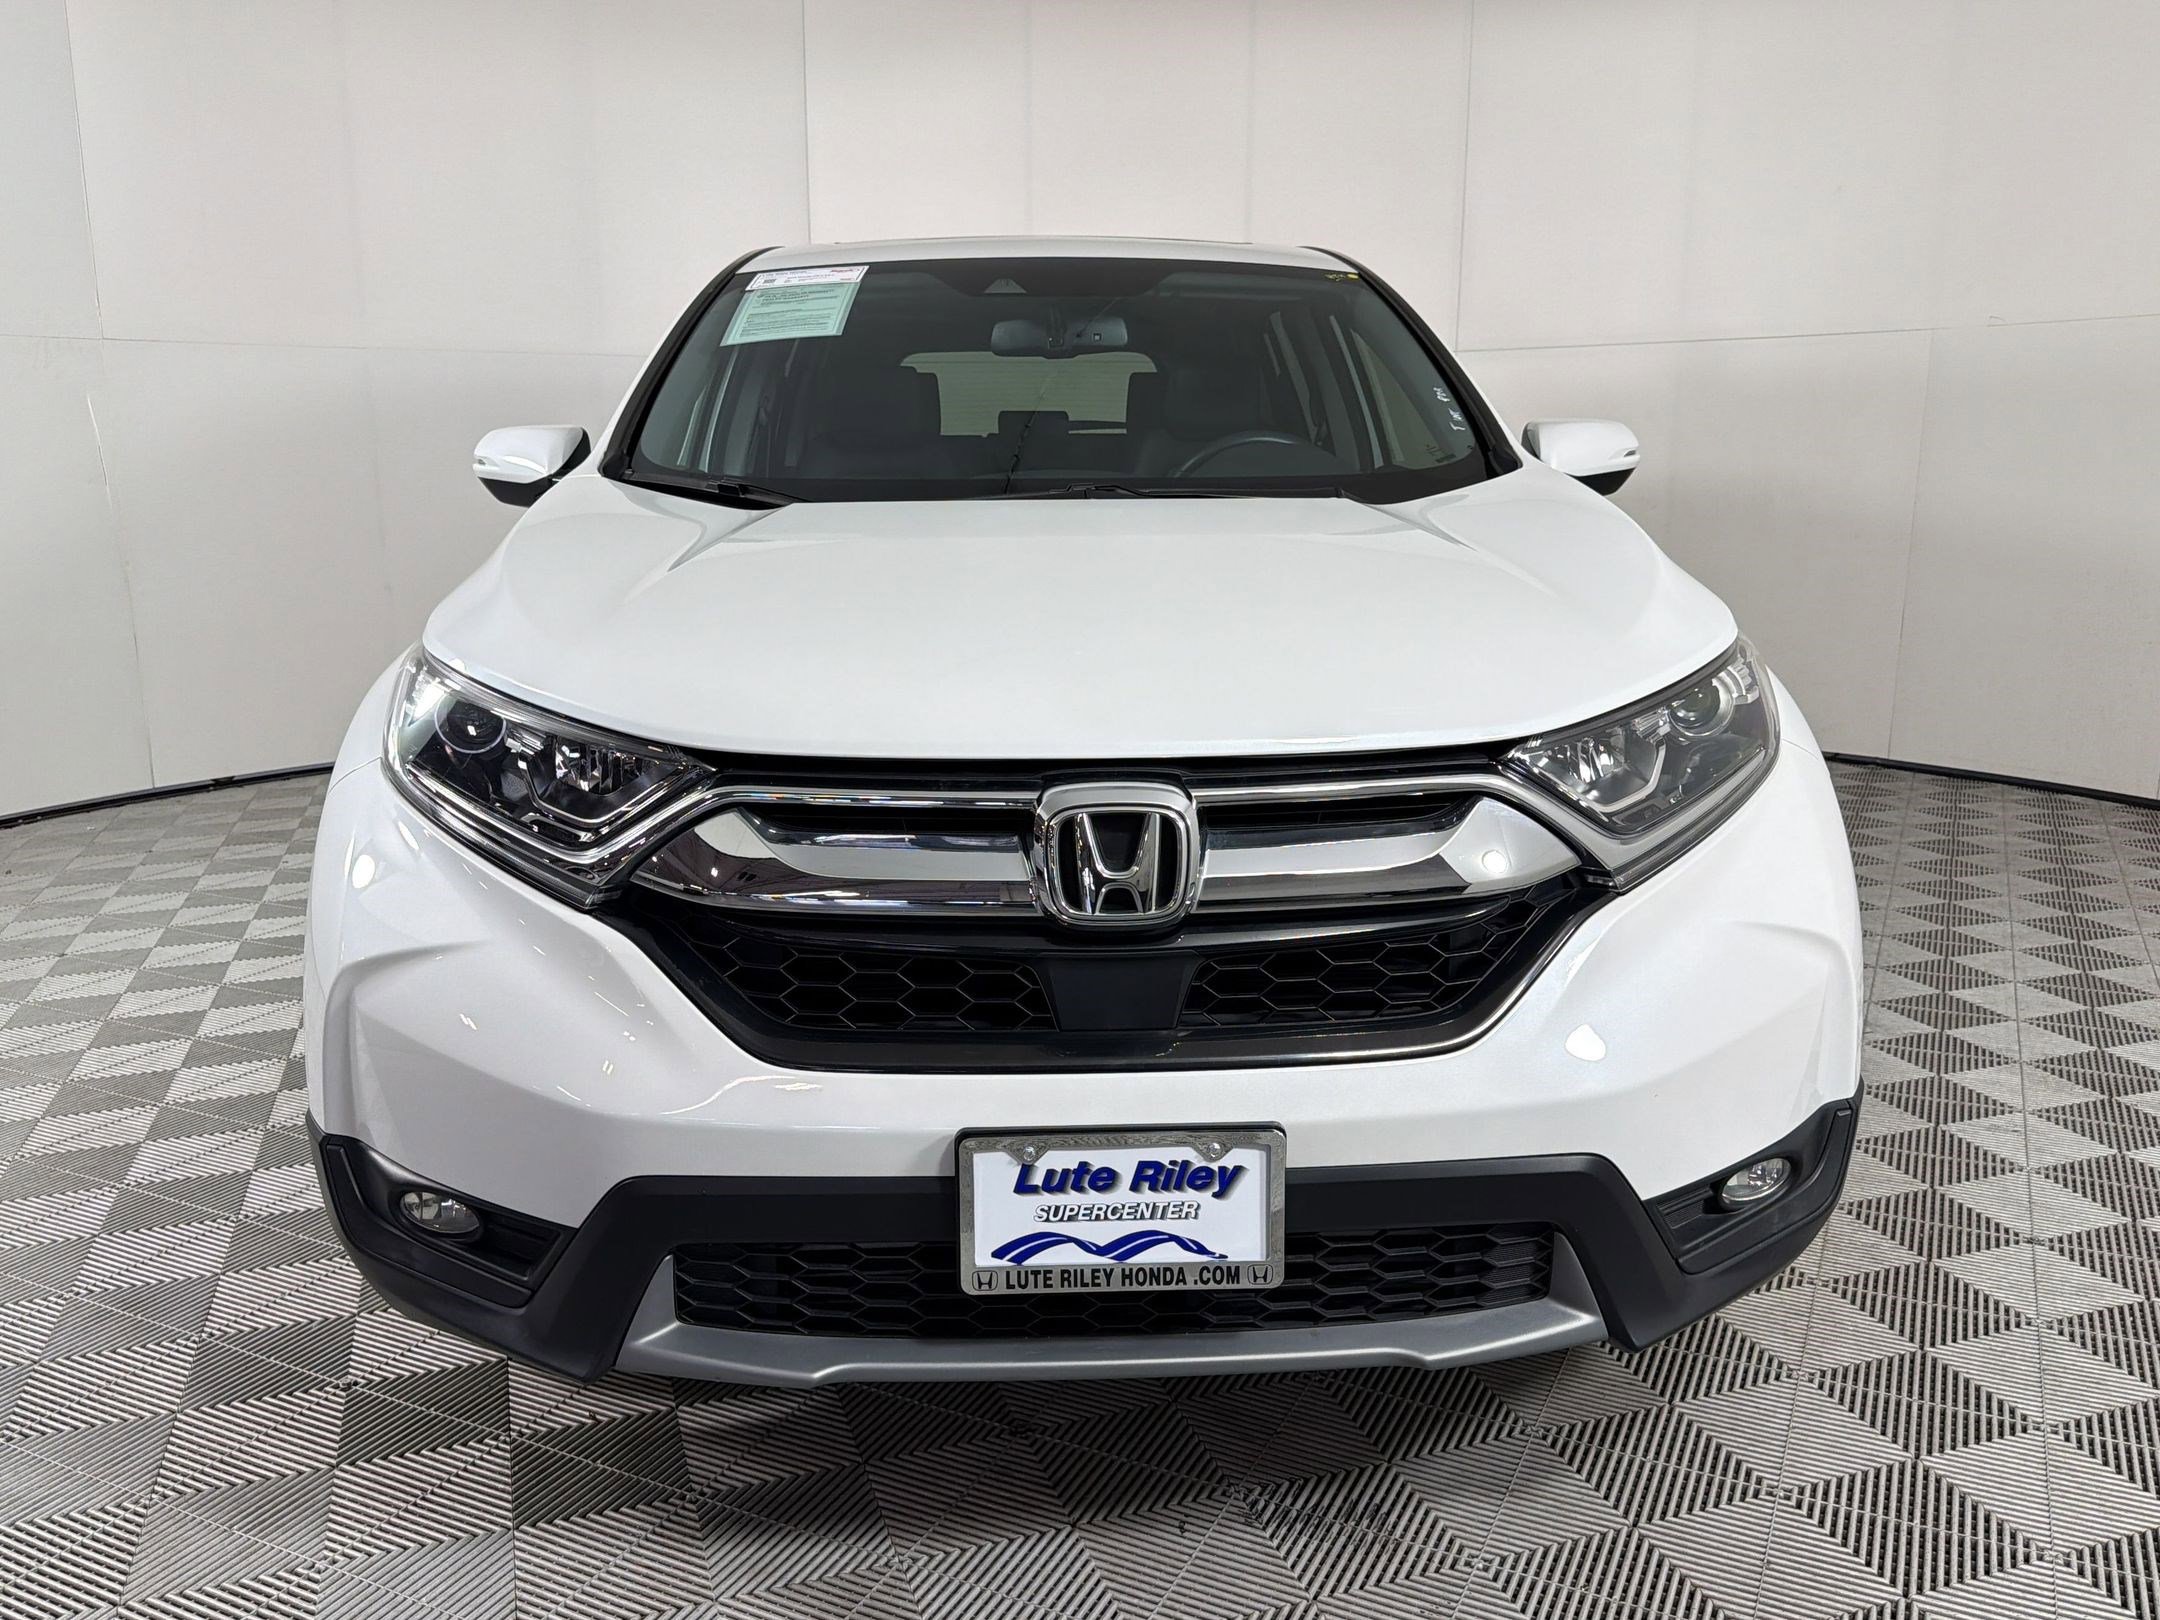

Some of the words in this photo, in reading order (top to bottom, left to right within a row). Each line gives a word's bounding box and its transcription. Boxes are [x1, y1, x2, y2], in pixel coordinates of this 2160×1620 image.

[1013, 1161, 1120, 1194] Lute
[1129, 1160, 1247, 1198] Riley
[1034, 1201, 1200, 1223] SUPERCENTER
[1005, 1270, 1053, 1289] LUTE
[1060, 1268, 1113, 1288] RILEY
[1121, 1267, 1186, 1287] HONDA
[1193, 1265, 1240, 1285] .COM
